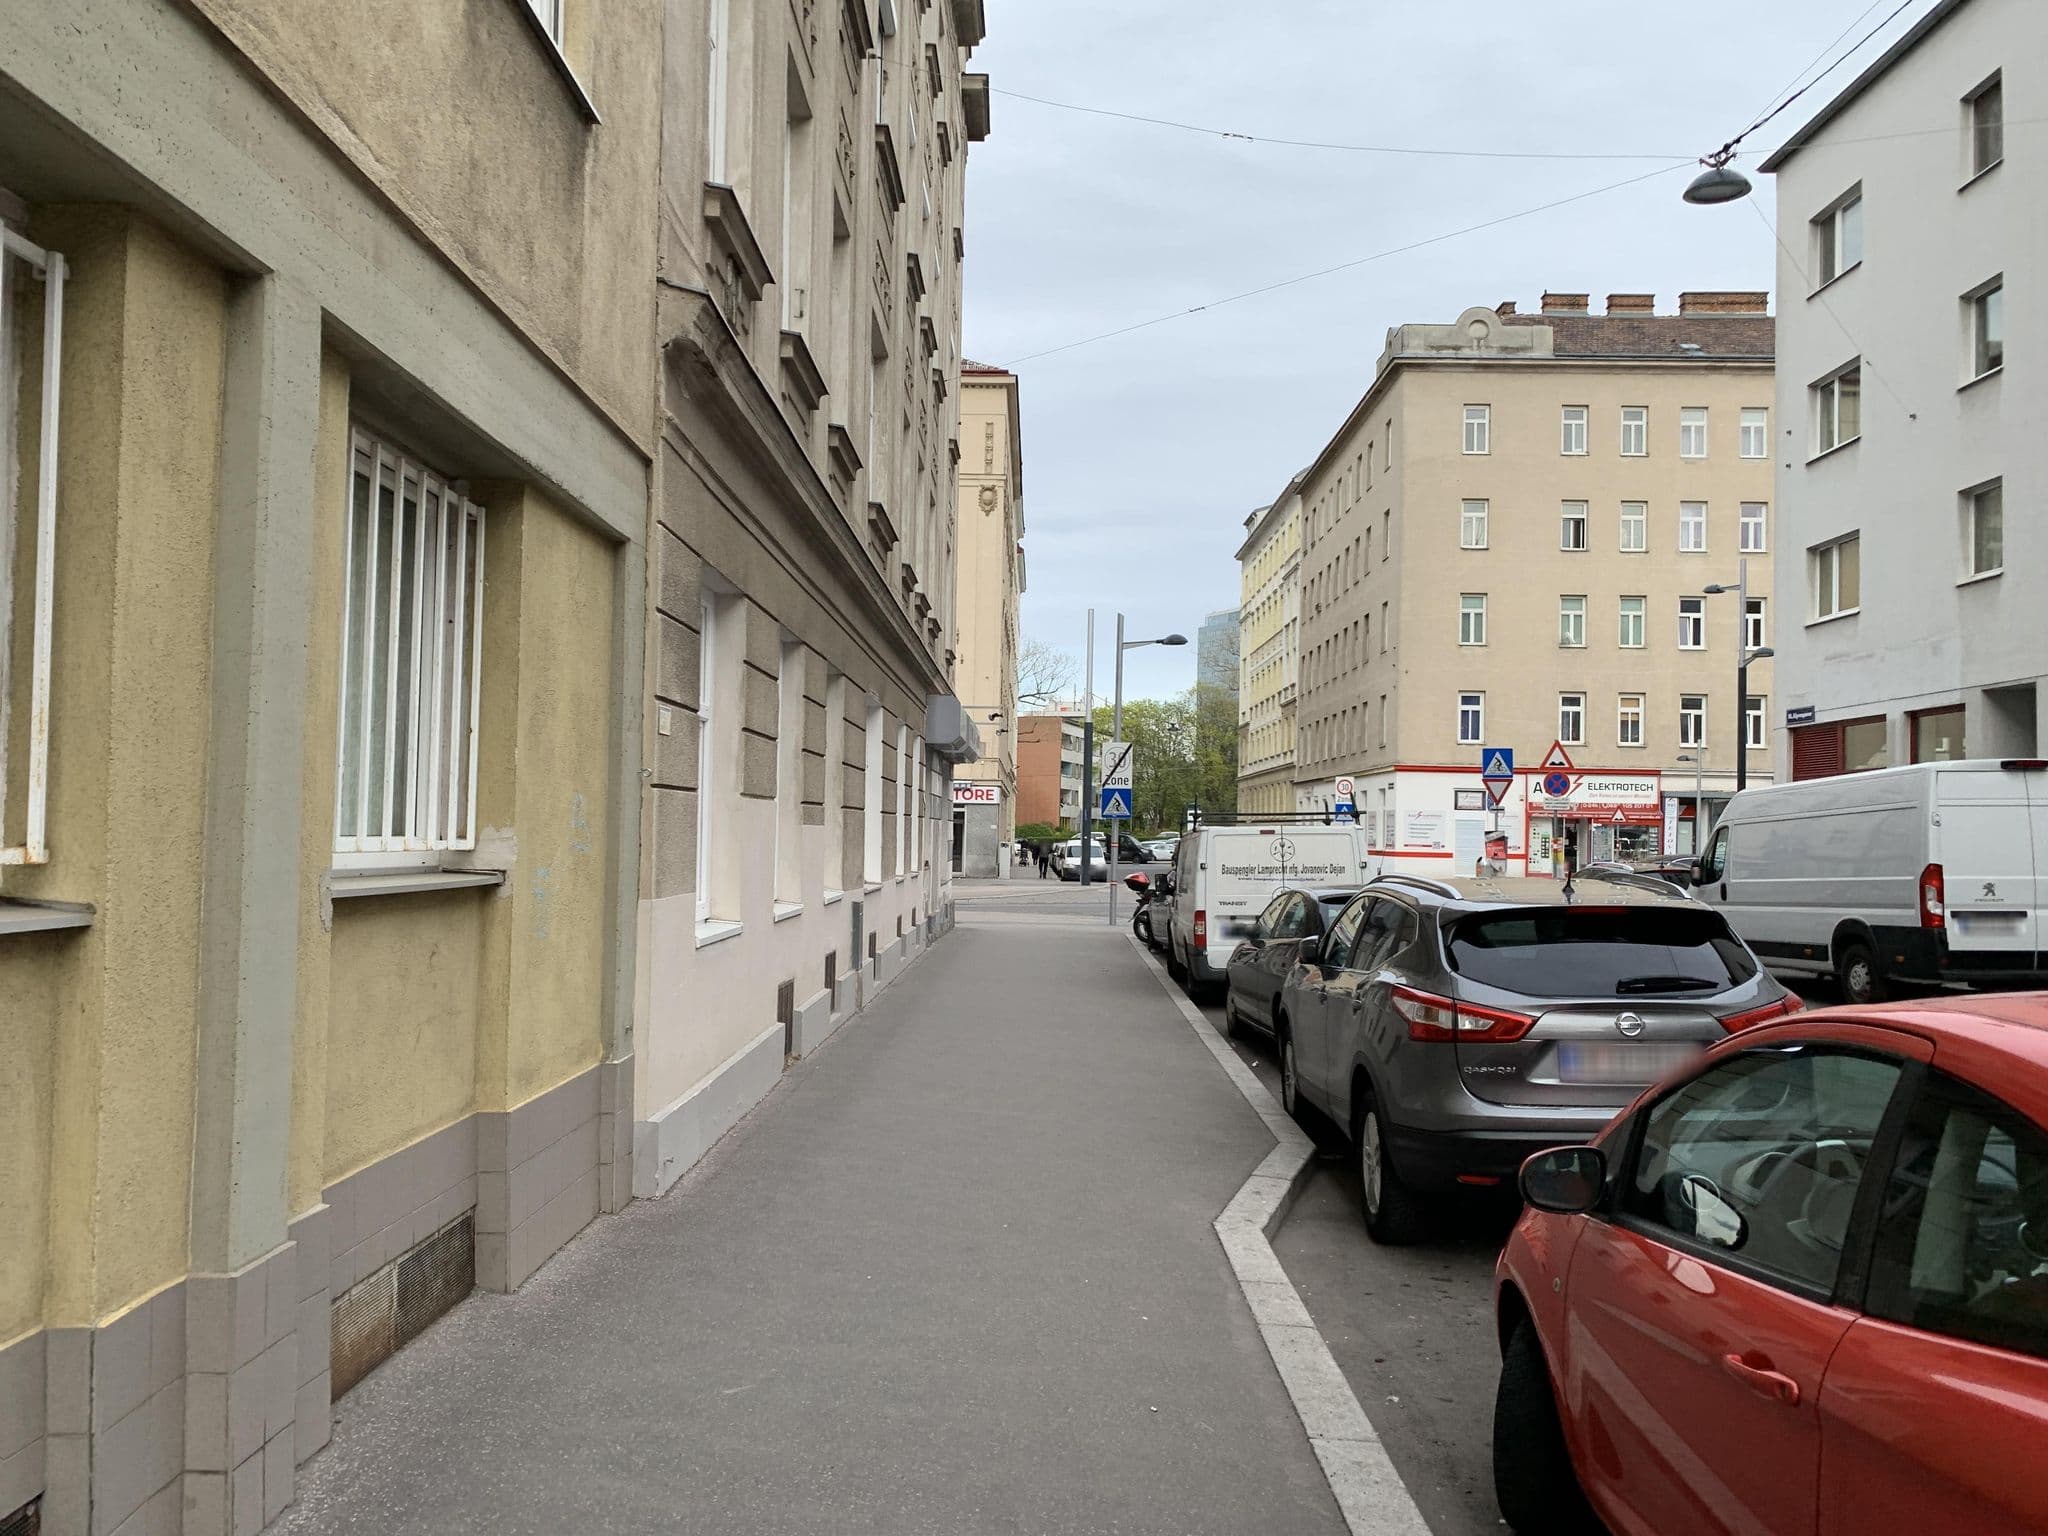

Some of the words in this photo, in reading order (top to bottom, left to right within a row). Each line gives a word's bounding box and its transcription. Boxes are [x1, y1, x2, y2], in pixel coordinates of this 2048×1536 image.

[1341, 783, 1350, 791] 30
[1588, 782, 1654, 792] ELEKTROTECH
[1221, 864, 1257, 877] Bauspengler
[1301, 864, 1328, 875] Jovanovic
[1329, 864, 1346, 877] Dejan
